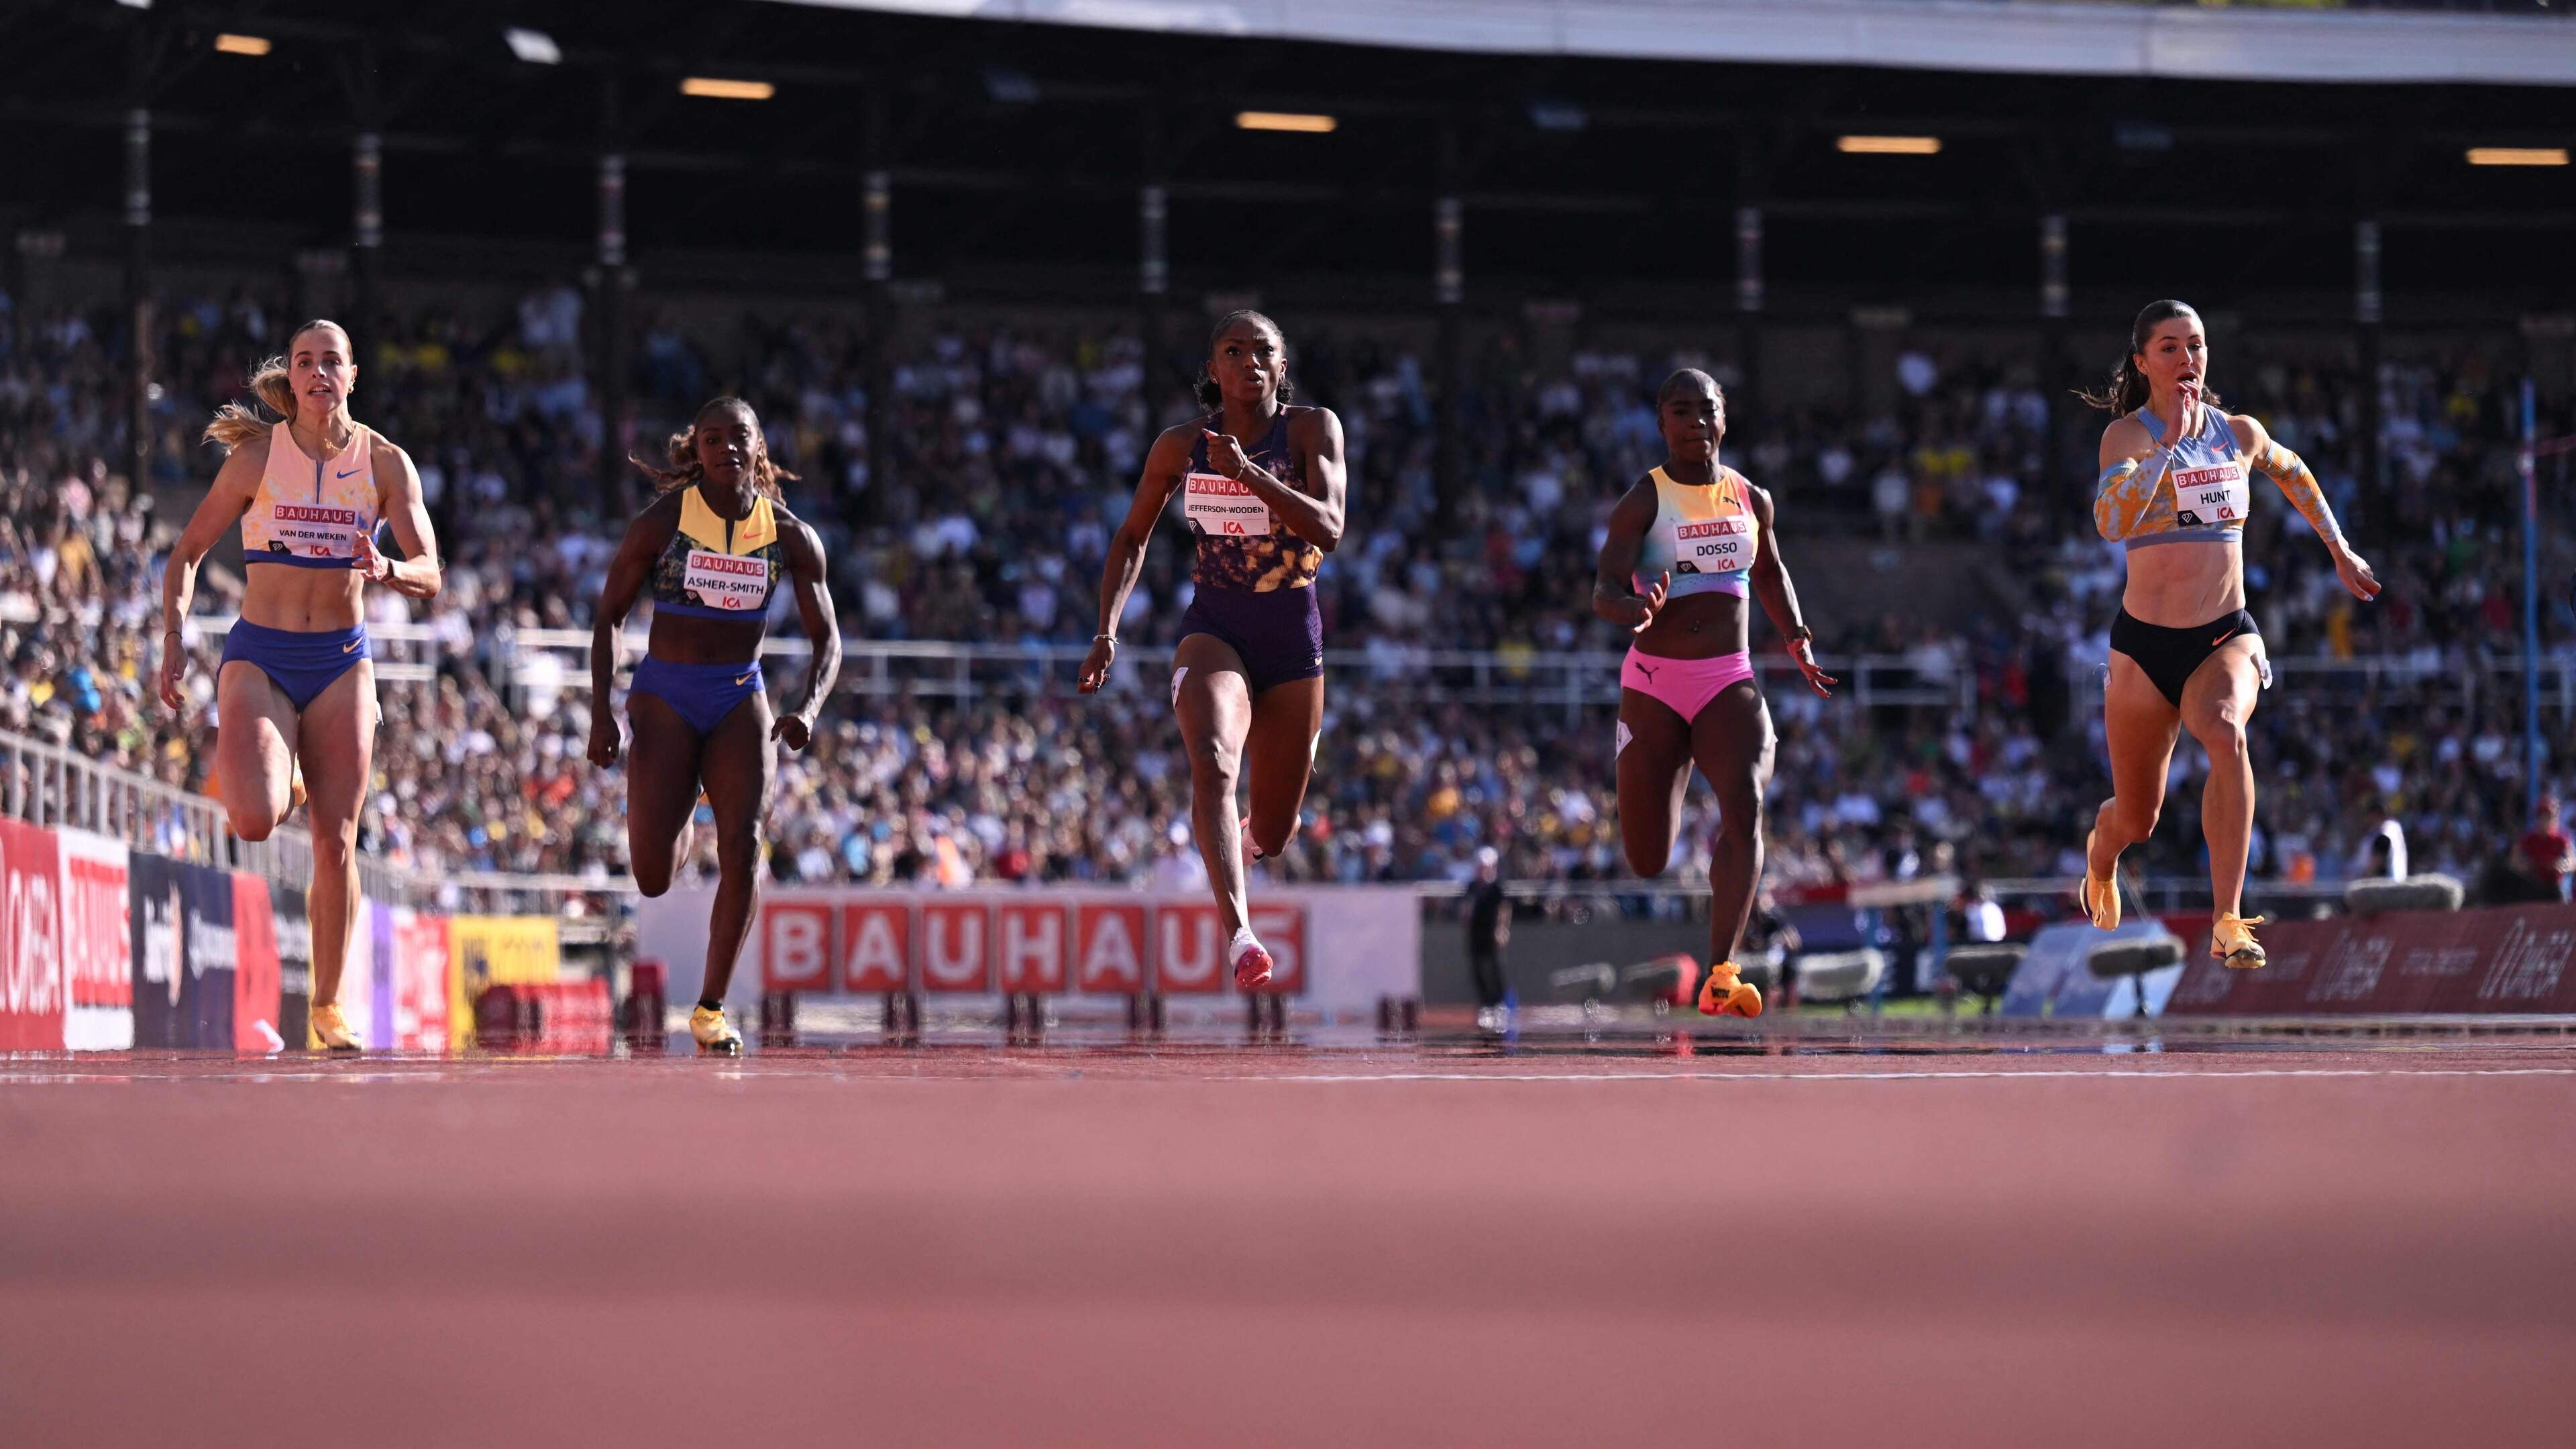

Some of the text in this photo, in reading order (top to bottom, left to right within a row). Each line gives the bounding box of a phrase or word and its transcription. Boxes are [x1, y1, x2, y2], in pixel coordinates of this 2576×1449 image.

[2178, 467, 2238, 486] BAUHAUS
[1189, 480, 1249, 494] BAUHAU
[2200, 490, 2231, 504] HUNT
[276, 507, 354, 523] BAUHAUS
[1187, 504, 1264, 514] JEFFERSON-WOODEN
[2216, 506, 2235, 520] ICA
[1223, 521, 1246, 534] ICA
[1679, 521, 1746, 538] BAUHAUS
[279, 529, 347, 541] VAN DER WEKEN
[310, 545, 331, 557] ICA
[1697, 542, 1737, 556] DOSSO
[692, 555, 765, 576] BAUHAUS
[1717, 558, 1735, 571] ICA
[687, 577, 764, 594] ASHER-SMITH
[722, 596, 741, 609] ICA
[770, 910, 1297, 981] BAUHAUS
